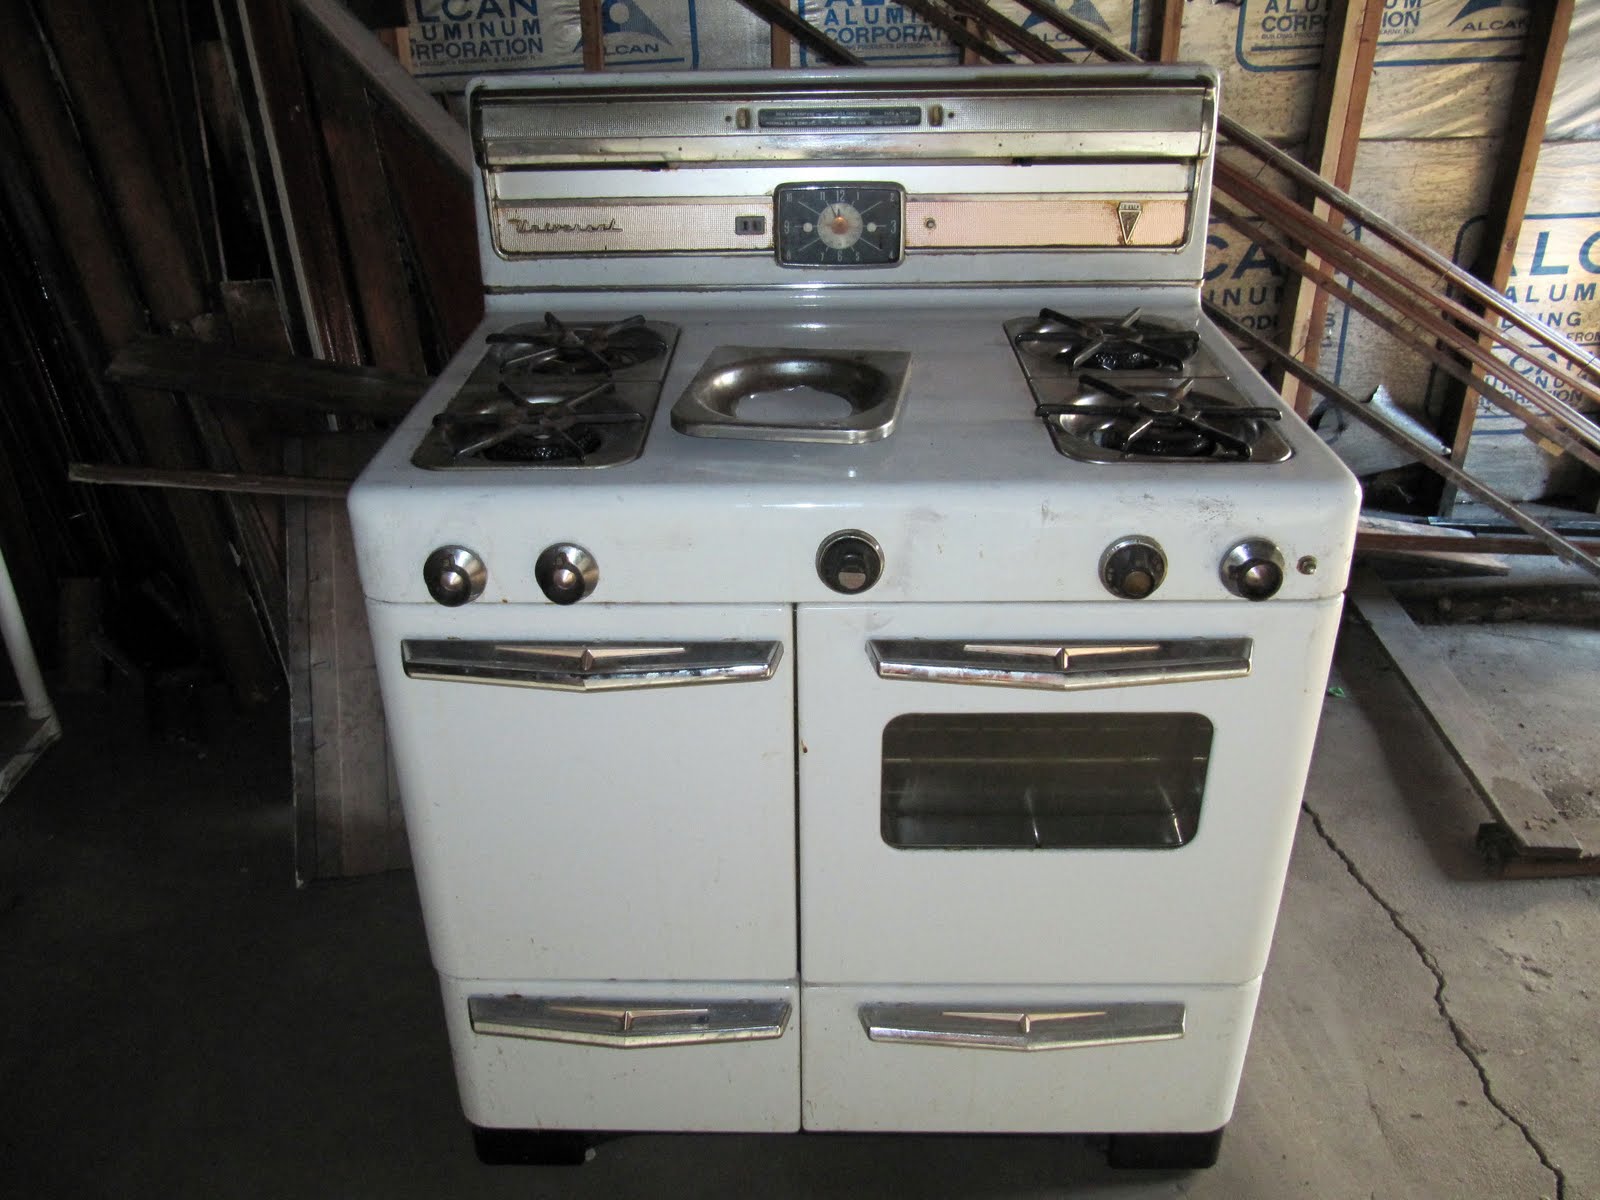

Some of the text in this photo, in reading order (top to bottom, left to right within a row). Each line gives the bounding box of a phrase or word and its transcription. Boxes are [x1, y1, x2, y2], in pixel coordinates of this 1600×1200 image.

[410, 18, 540, 41] UMINUM
[836, 190, 846, 202] 12
[890, 220, 897, 234] 3
